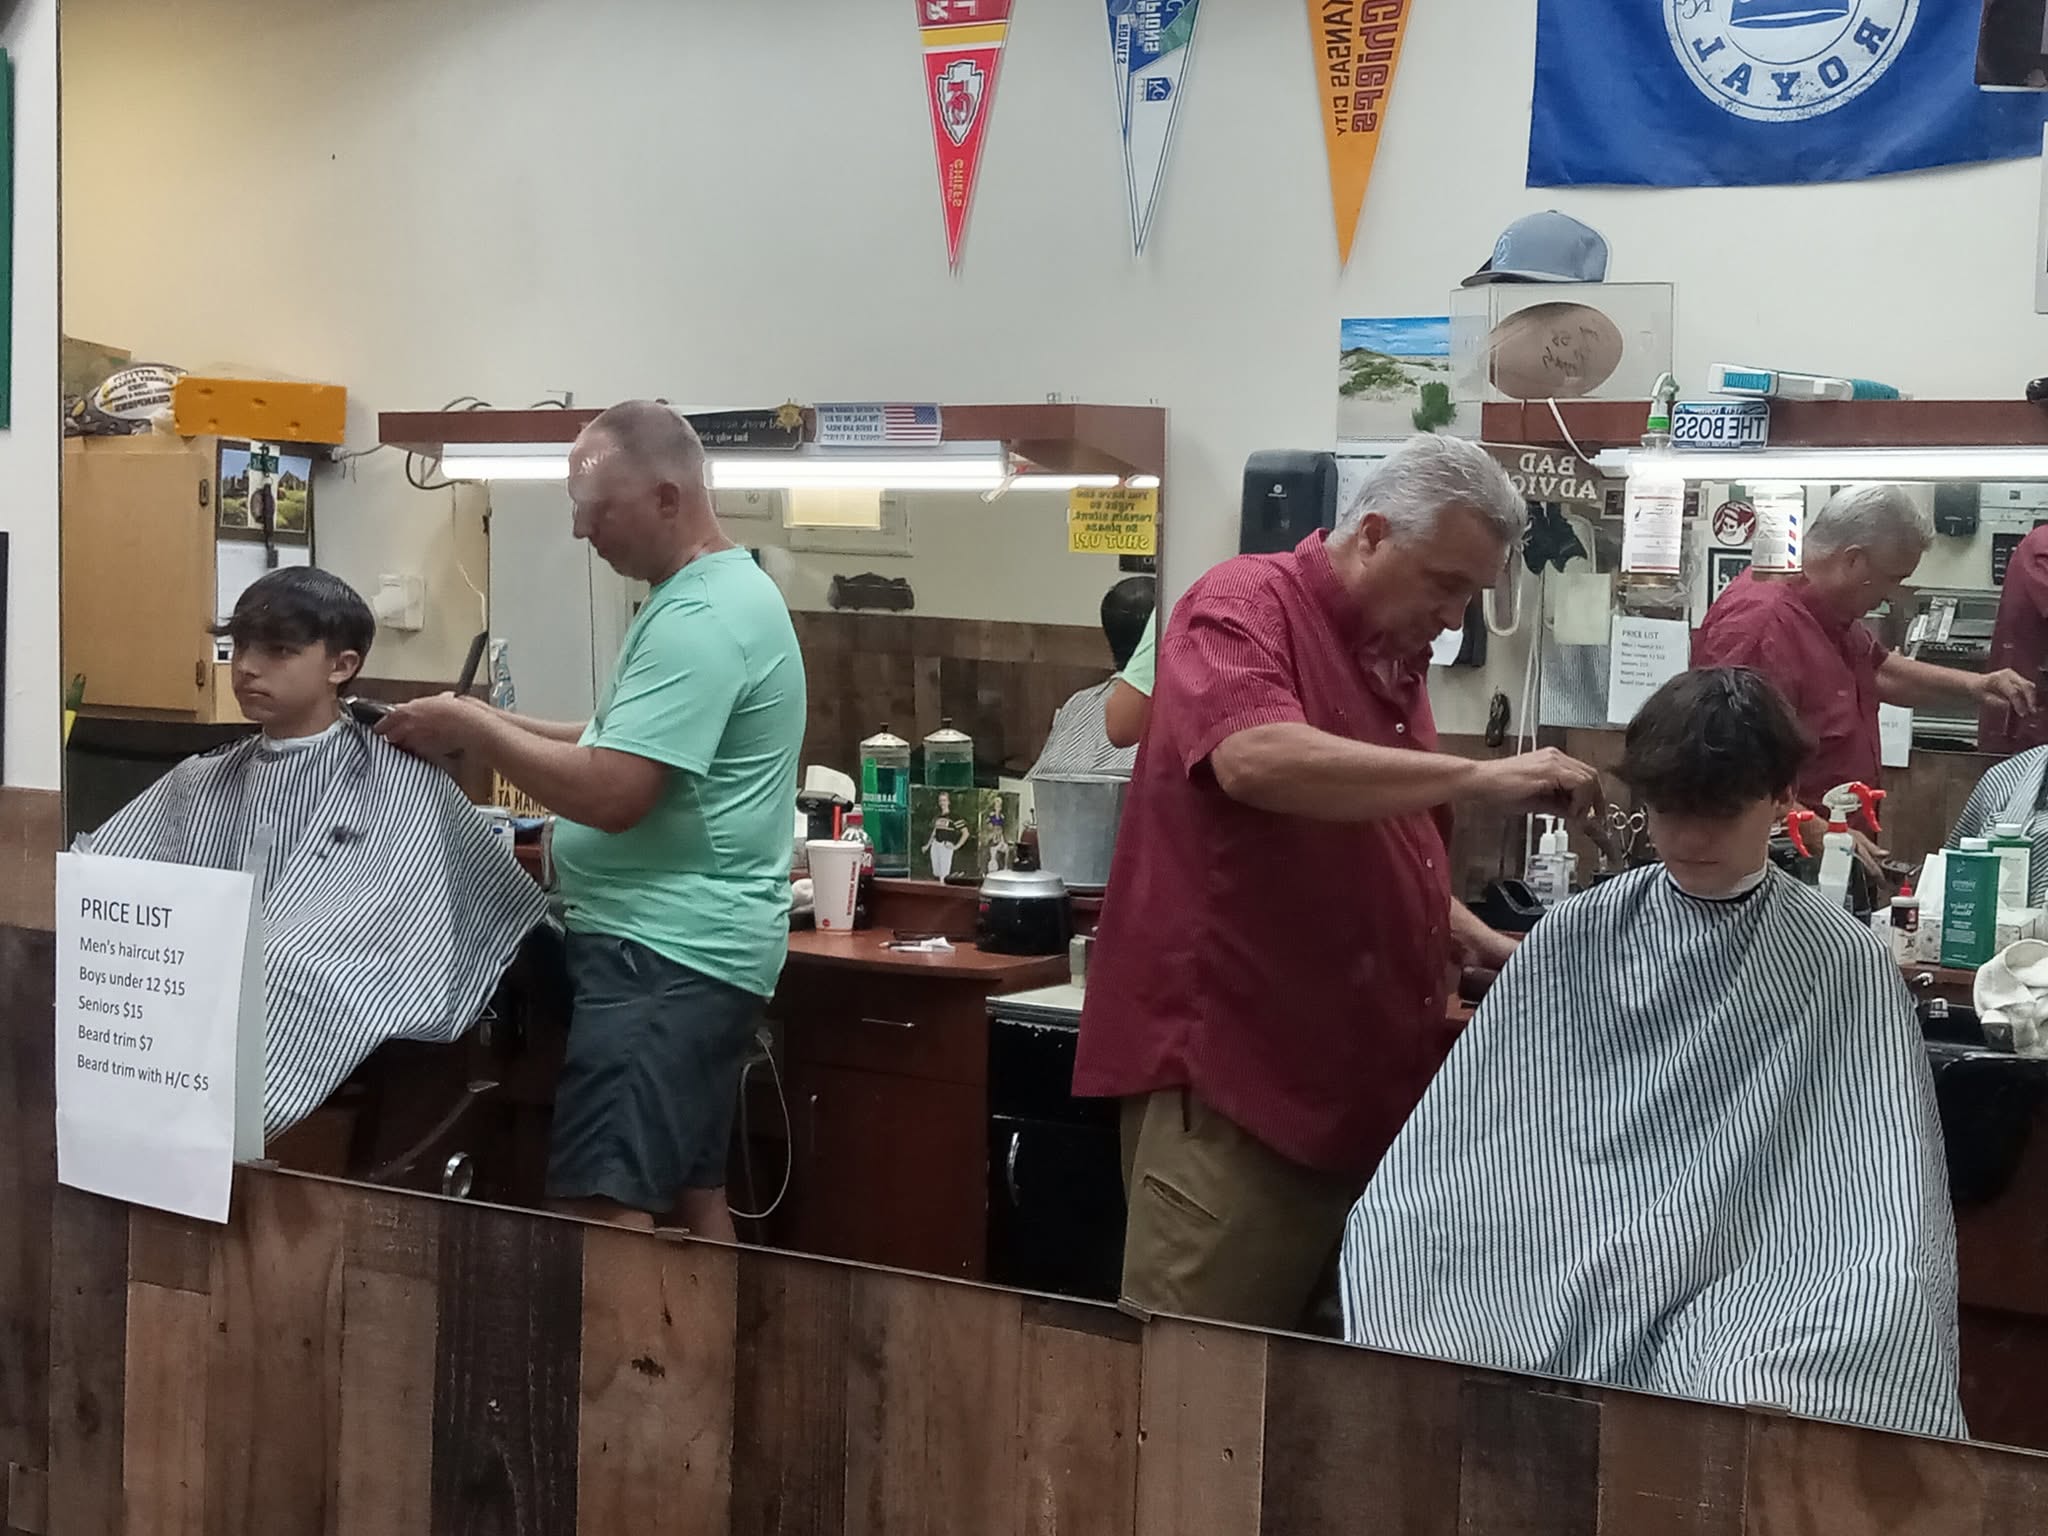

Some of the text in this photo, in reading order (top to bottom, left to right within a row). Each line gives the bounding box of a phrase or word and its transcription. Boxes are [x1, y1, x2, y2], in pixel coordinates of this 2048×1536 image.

[80, 898, 173, 929] PRICE LIST
[79, 937, 185, 966] Men's haircut $17
[79, 966, 185, 996] Boys under 12 $15
[78, 995, 143, 1020] Seniors $15
[78, 1024, 153, 1052] Beard trim $7
[77, 1054, 209, 1091] Beard trim with H/C $5
